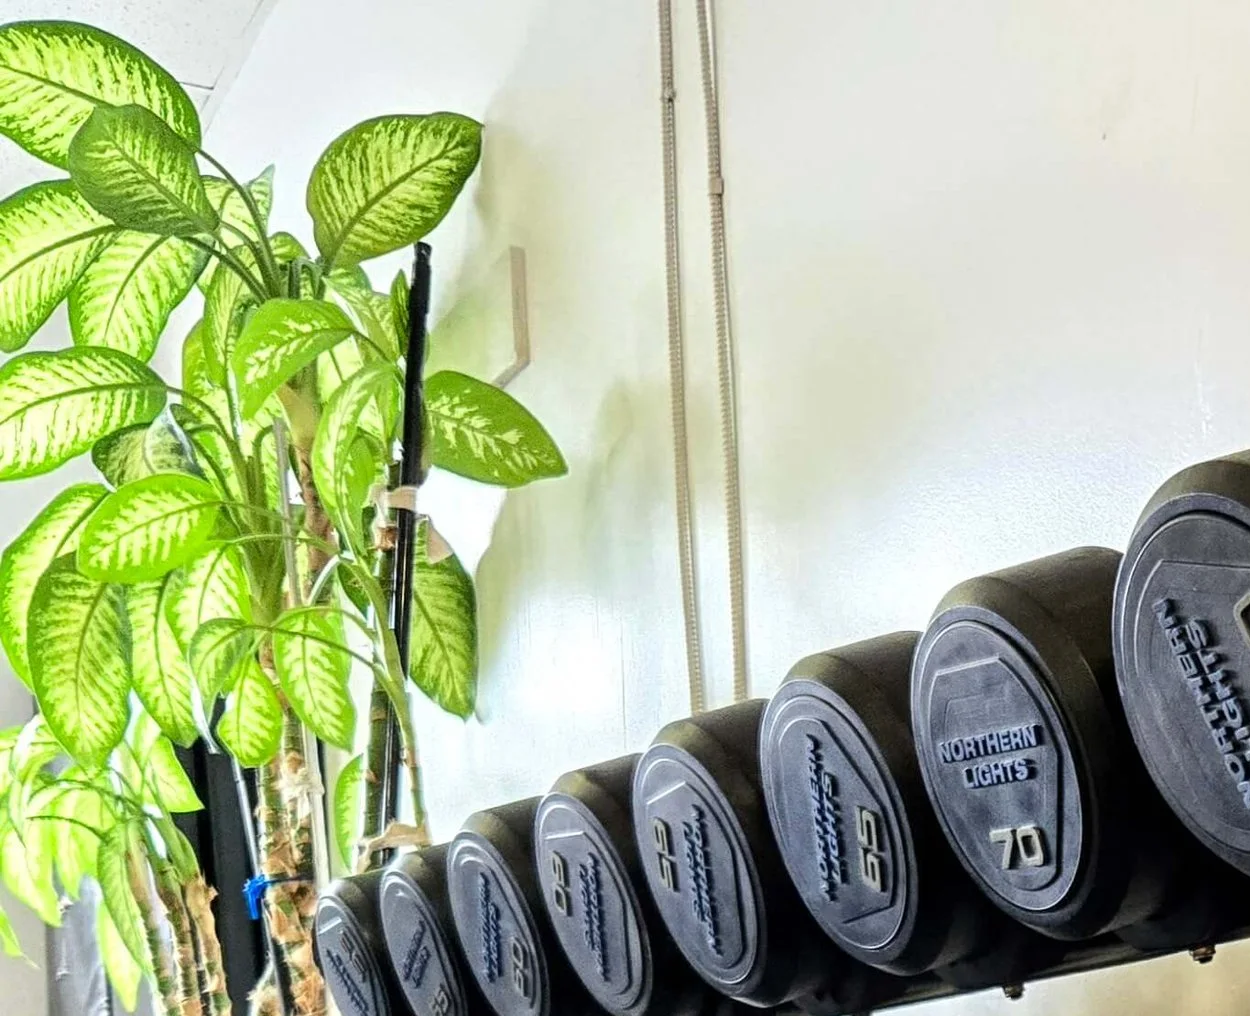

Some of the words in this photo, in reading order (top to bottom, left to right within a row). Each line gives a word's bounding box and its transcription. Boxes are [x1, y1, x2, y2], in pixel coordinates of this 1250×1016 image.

[938, 724, 1040, 763] NORTHERN
[962, 759, 1031, 789] LIGHTS
[806, 734, 834, 901] NORTHERN
[821, 771, 843, 884] LIGHTS
[855, 805, 882, 893] 65
[989, 824, 1044, 870] 70
[552, 851, 569, 917] 60
[652, 817, 675, 893] 65
